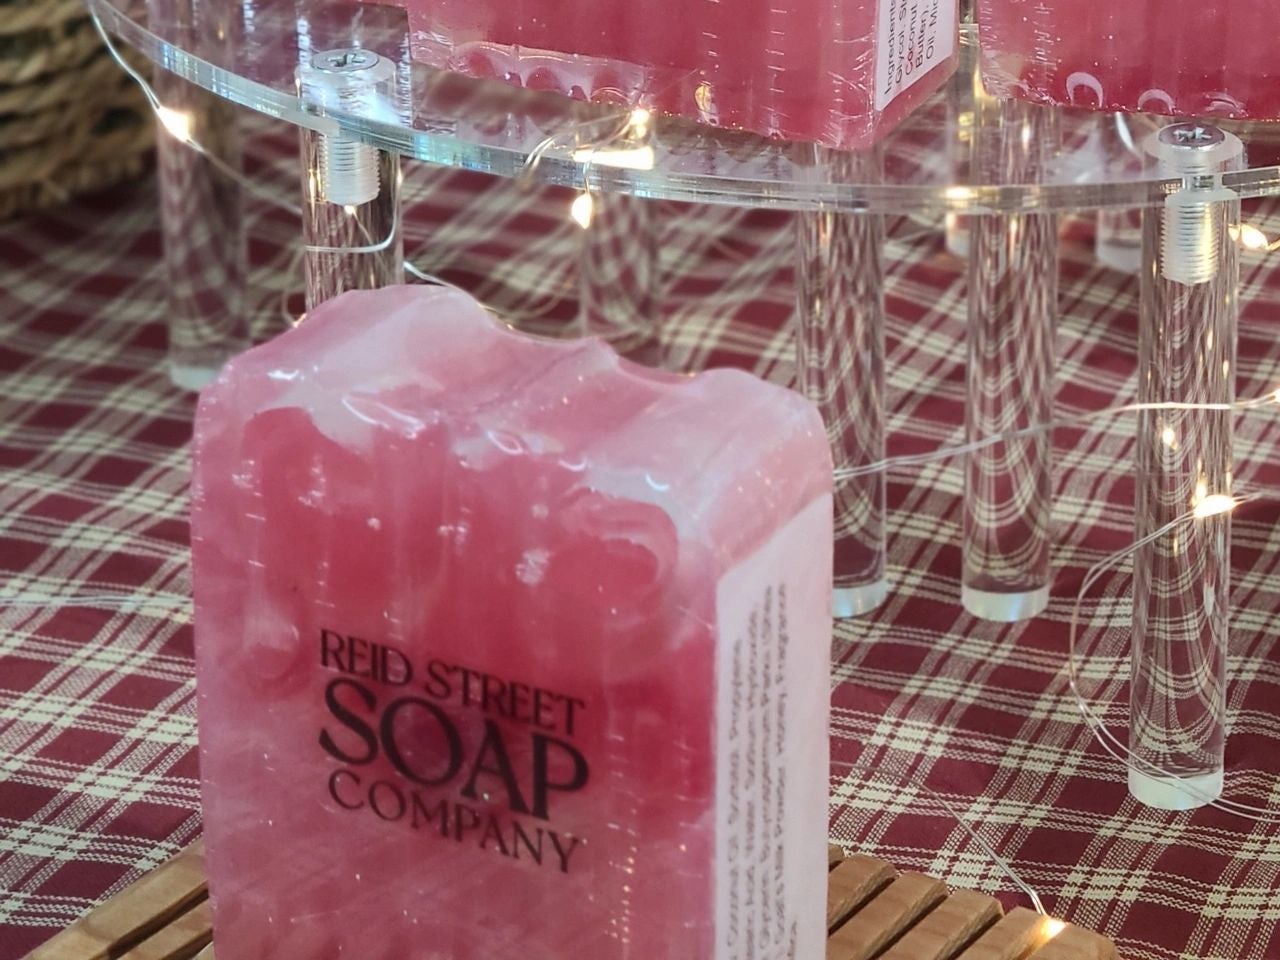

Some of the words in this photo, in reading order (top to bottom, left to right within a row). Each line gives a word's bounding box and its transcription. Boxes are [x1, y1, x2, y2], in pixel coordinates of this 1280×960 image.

[905, 3, 917, 75] Coconut
[320, 629, 414, 687] REID
[425, 659, 585, 736] STREET
[319, 677, 590, 820] SOAP
[329, 769, 580, 873] COMPANY
